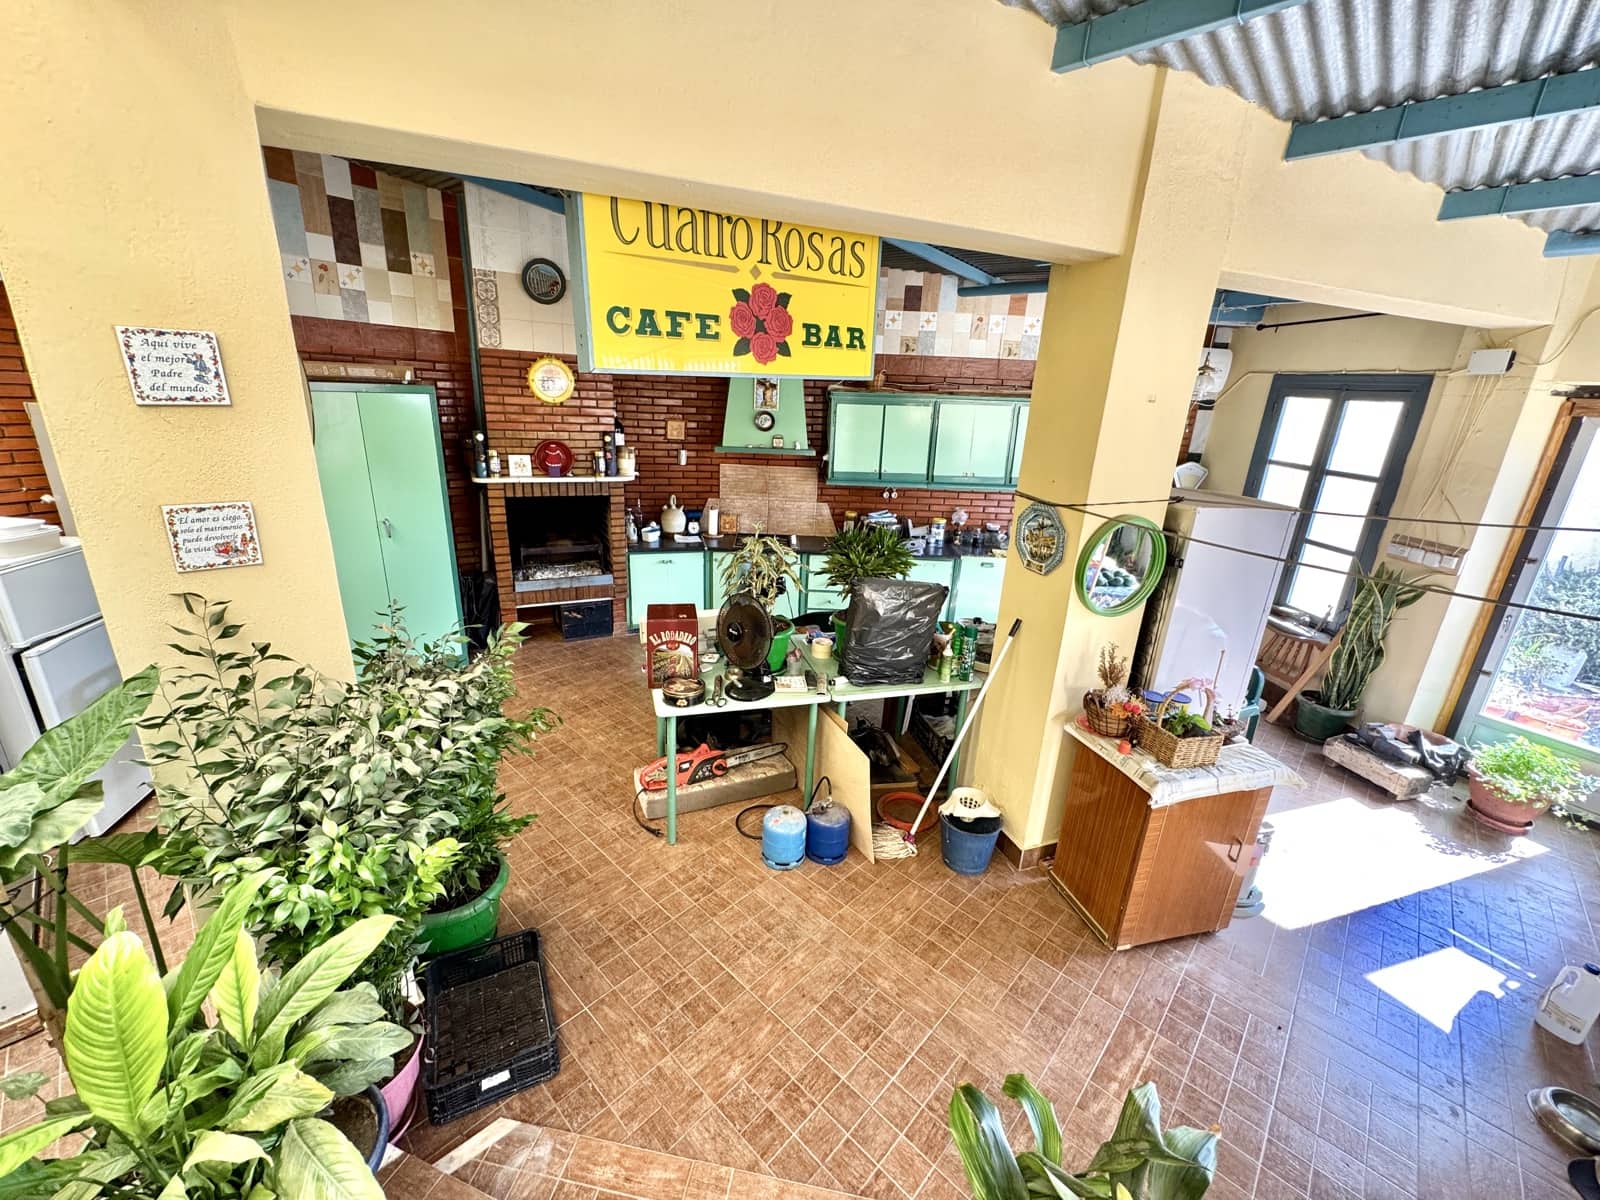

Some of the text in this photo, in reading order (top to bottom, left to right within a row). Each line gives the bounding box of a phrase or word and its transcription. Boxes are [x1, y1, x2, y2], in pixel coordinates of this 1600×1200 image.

[609, 196, 866, 279] Cuatro Rosas
[606, 305, 721, 340] CAFE
[801, 323, 867, 350] BAR
[172, 341, 197, 350] vive
[140, 353, 185, 366] el mejor
[151, 369, 183, 378] Padre
[149, 383, 208, 393] del mundo.
[178, 515, 189, 525] El
[212, 515, 220, 523] es
[204, 524, 243, 533] matrimonio
[182, 537, 202, 546] puede
[185, 546, 192, 554] la
